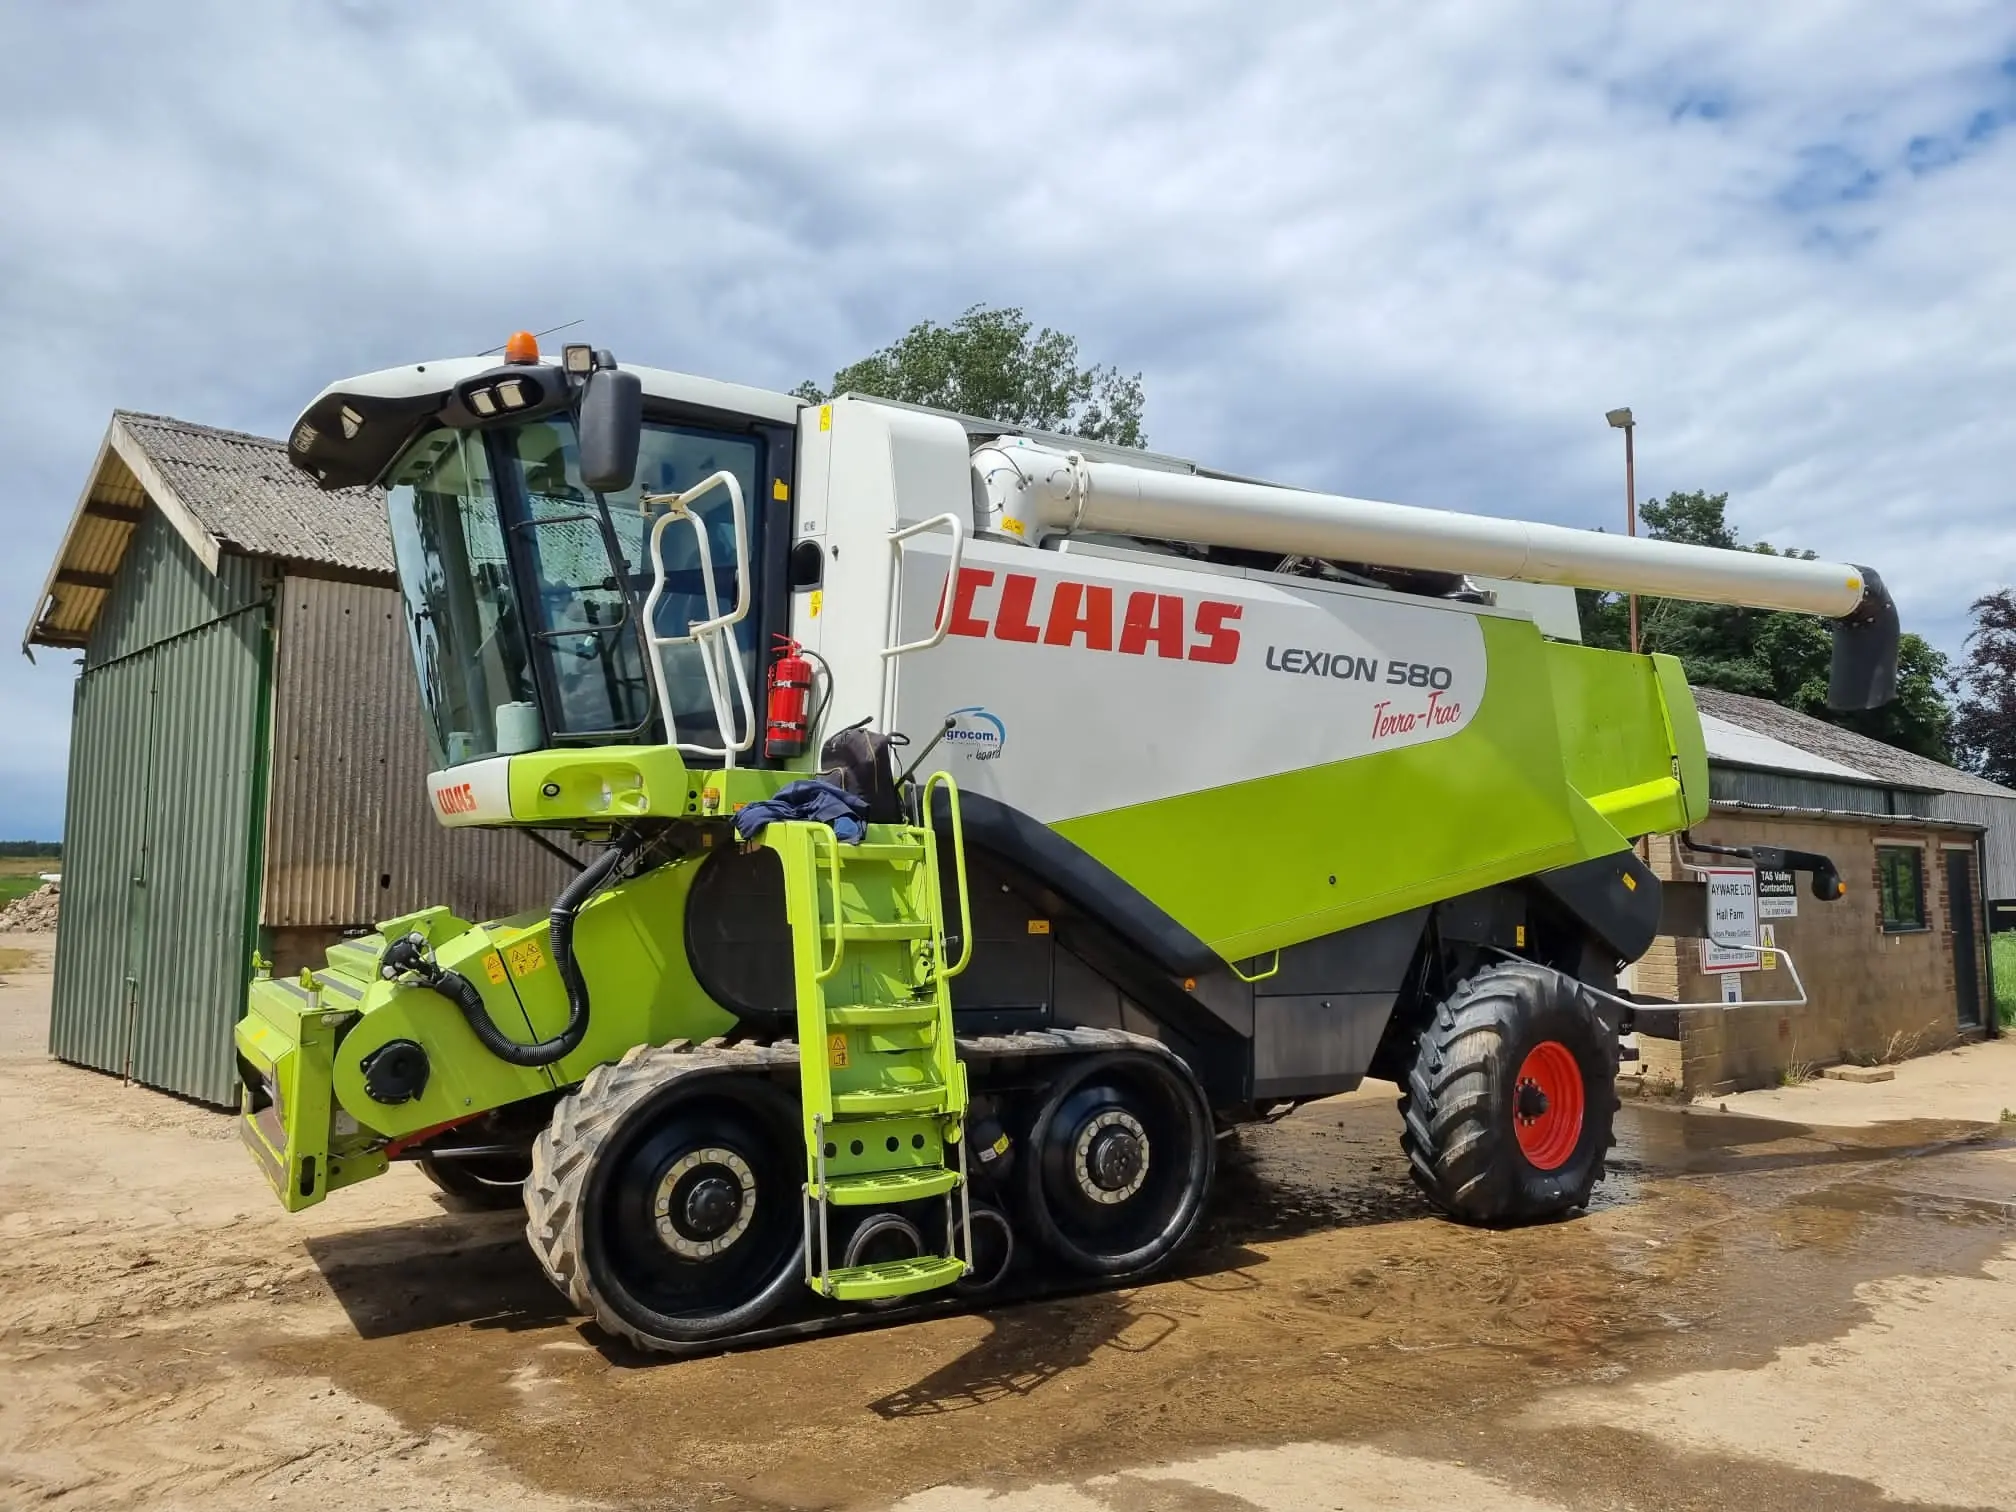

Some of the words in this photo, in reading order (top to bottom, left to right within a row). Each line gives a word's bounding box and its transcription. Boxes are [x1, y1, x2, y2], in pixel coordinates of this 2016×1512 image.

[935, 567, 1243, 665] CLAAS
[1265, 645, 1378, 683] LEXION
[1386, 660, 1453, 692] 580
[1371, 690, 1462, 741] Terra-Trac
[942, 728, 998, 741] grocom.
[1761, 871, 1773, 881] TAS
[1774, 871, 1792, 883] Valley
[1740, 884, 1752, 896] LTD
[1759, 883, 1794, 894] Contracting
[1716, 908, 1729, 921] Hall
[1730, 908, 1744, 920] Farm
